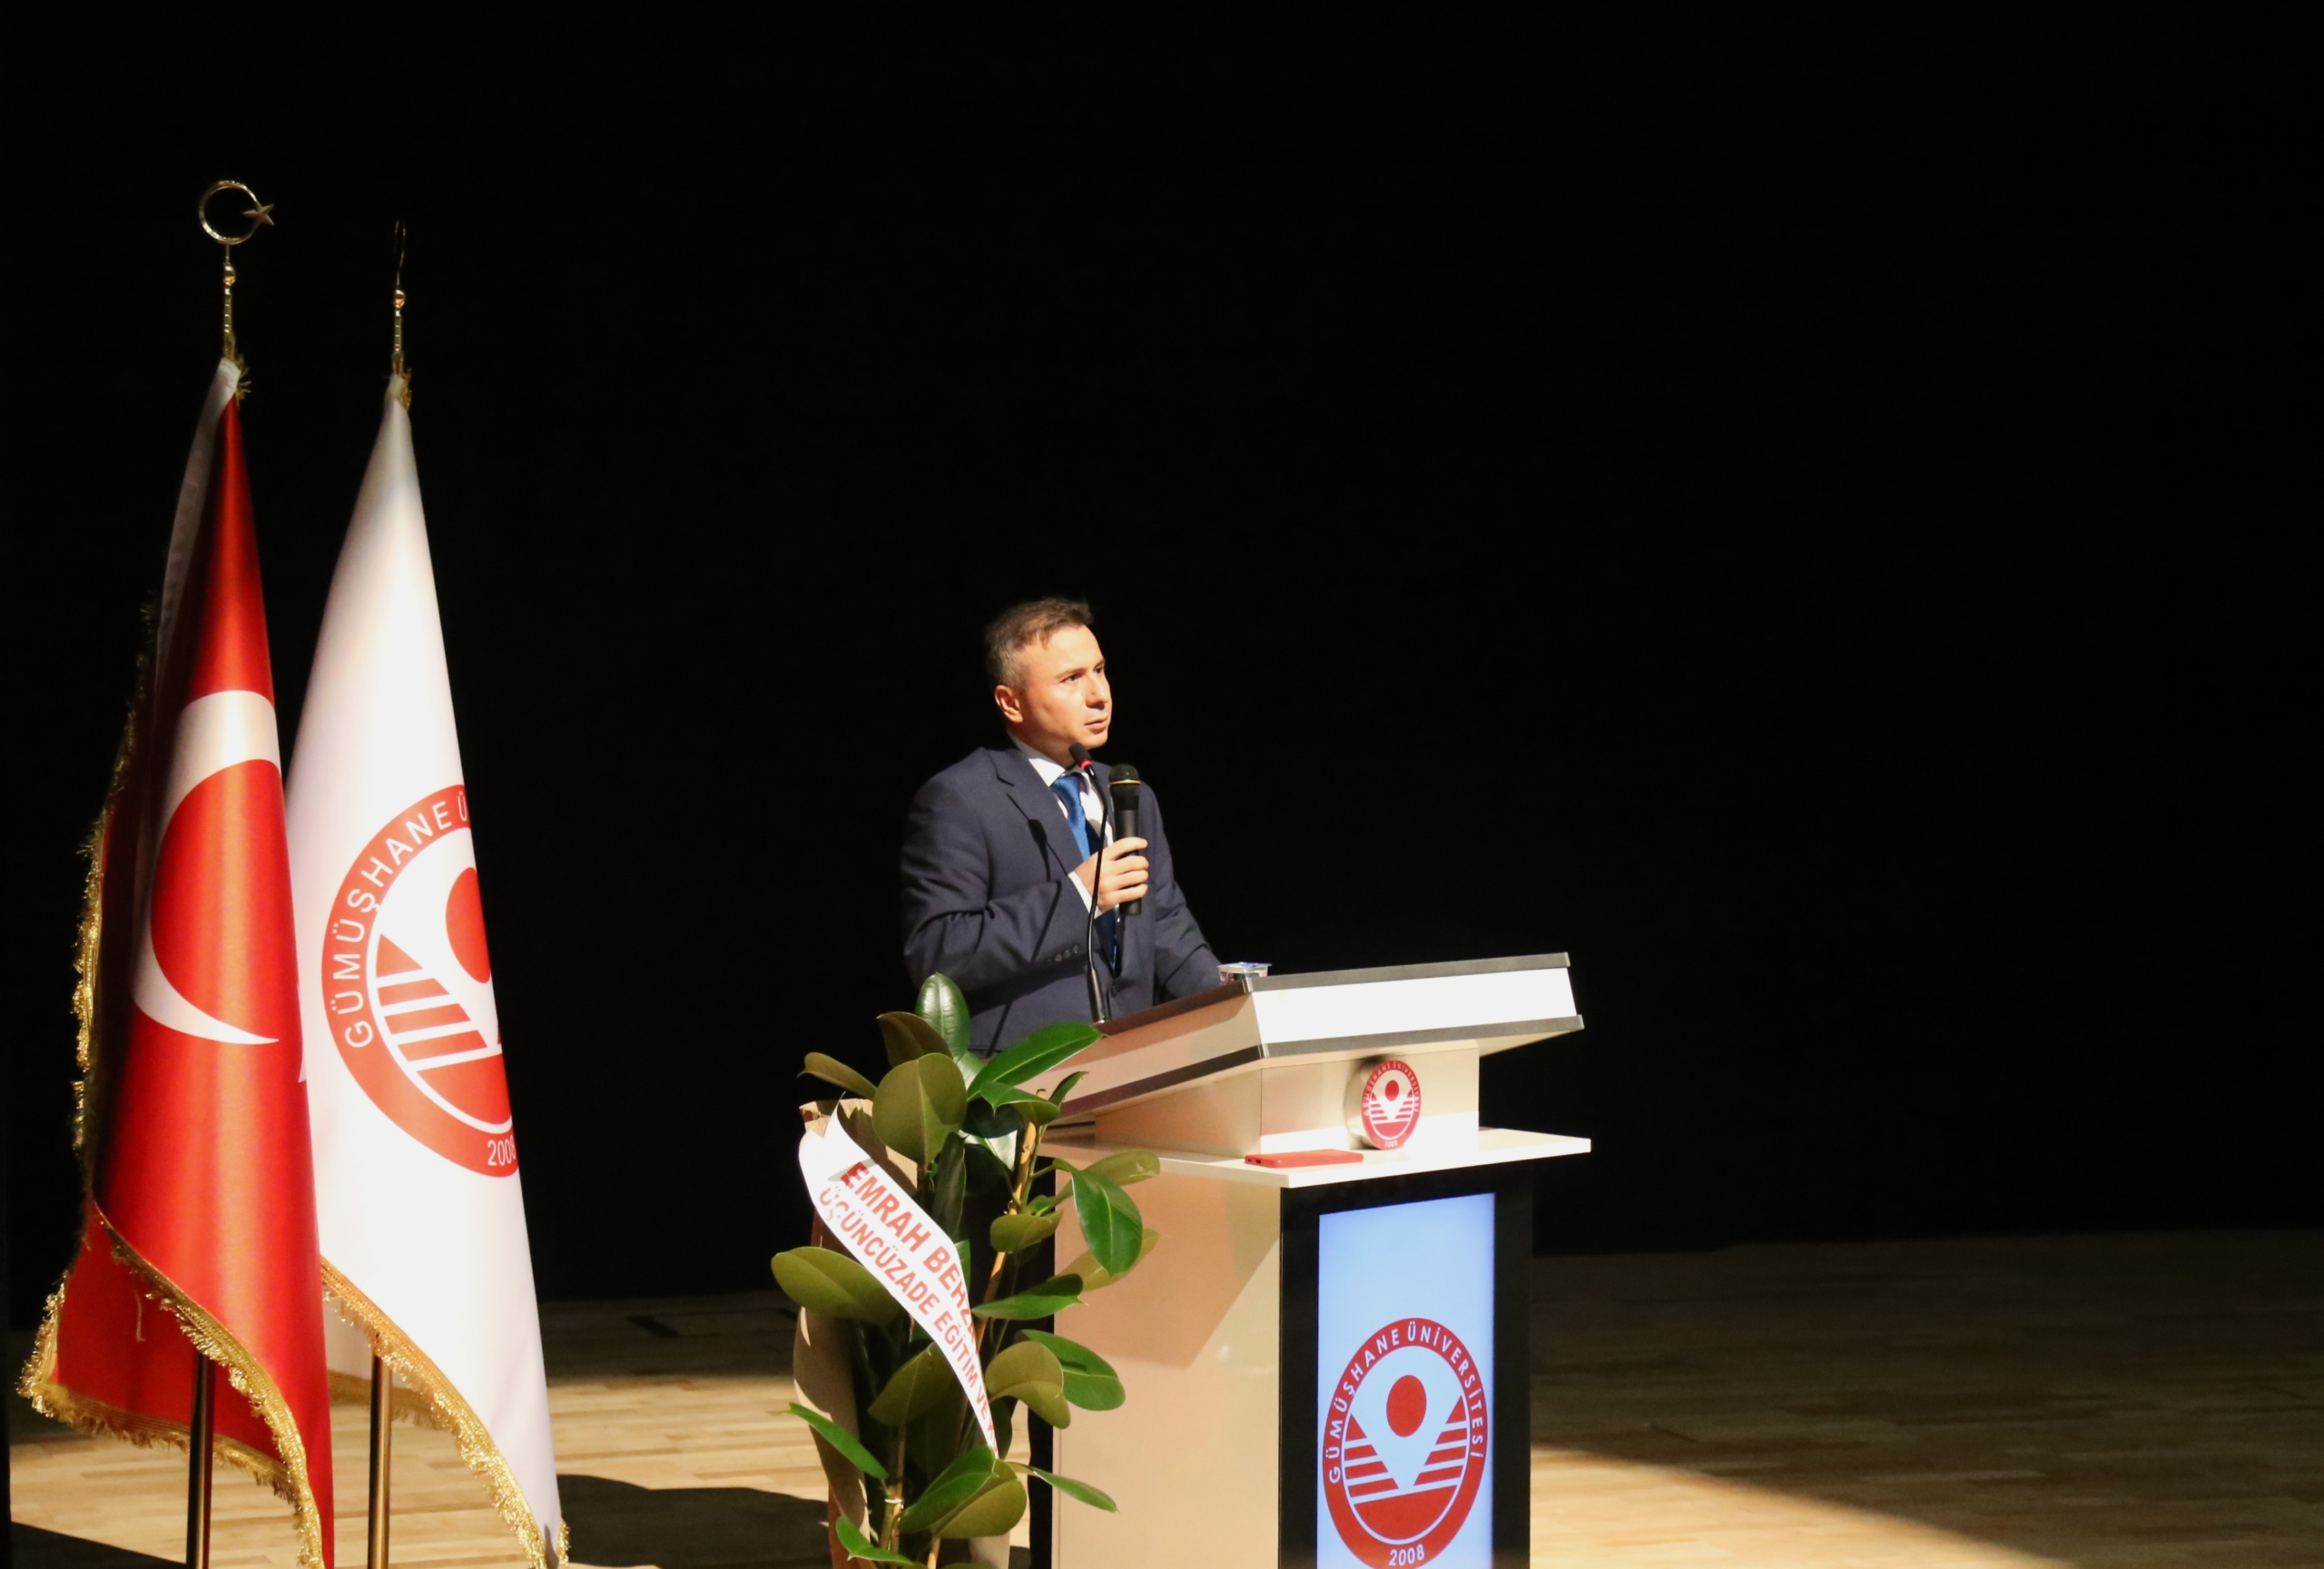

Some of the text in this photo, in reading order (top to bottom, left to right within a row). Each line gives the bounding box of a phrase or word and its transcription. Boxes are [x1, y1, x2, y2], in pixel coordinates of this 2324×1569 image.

[330, 801, 452, 1048] GÜMÜŞHANE
[819, 1185, 940, 1316] ÜÇÜNCÜZADE
[933, 1310, 978, 1388] EĞİTİM
[840, 1161, 931, 1253] EMRAH
[1325, 1321, 1483, 1484] GÜMÜŞHANE ÜNİVERSİTESİ
[1389, 1544, 1425, 1566] 2008
